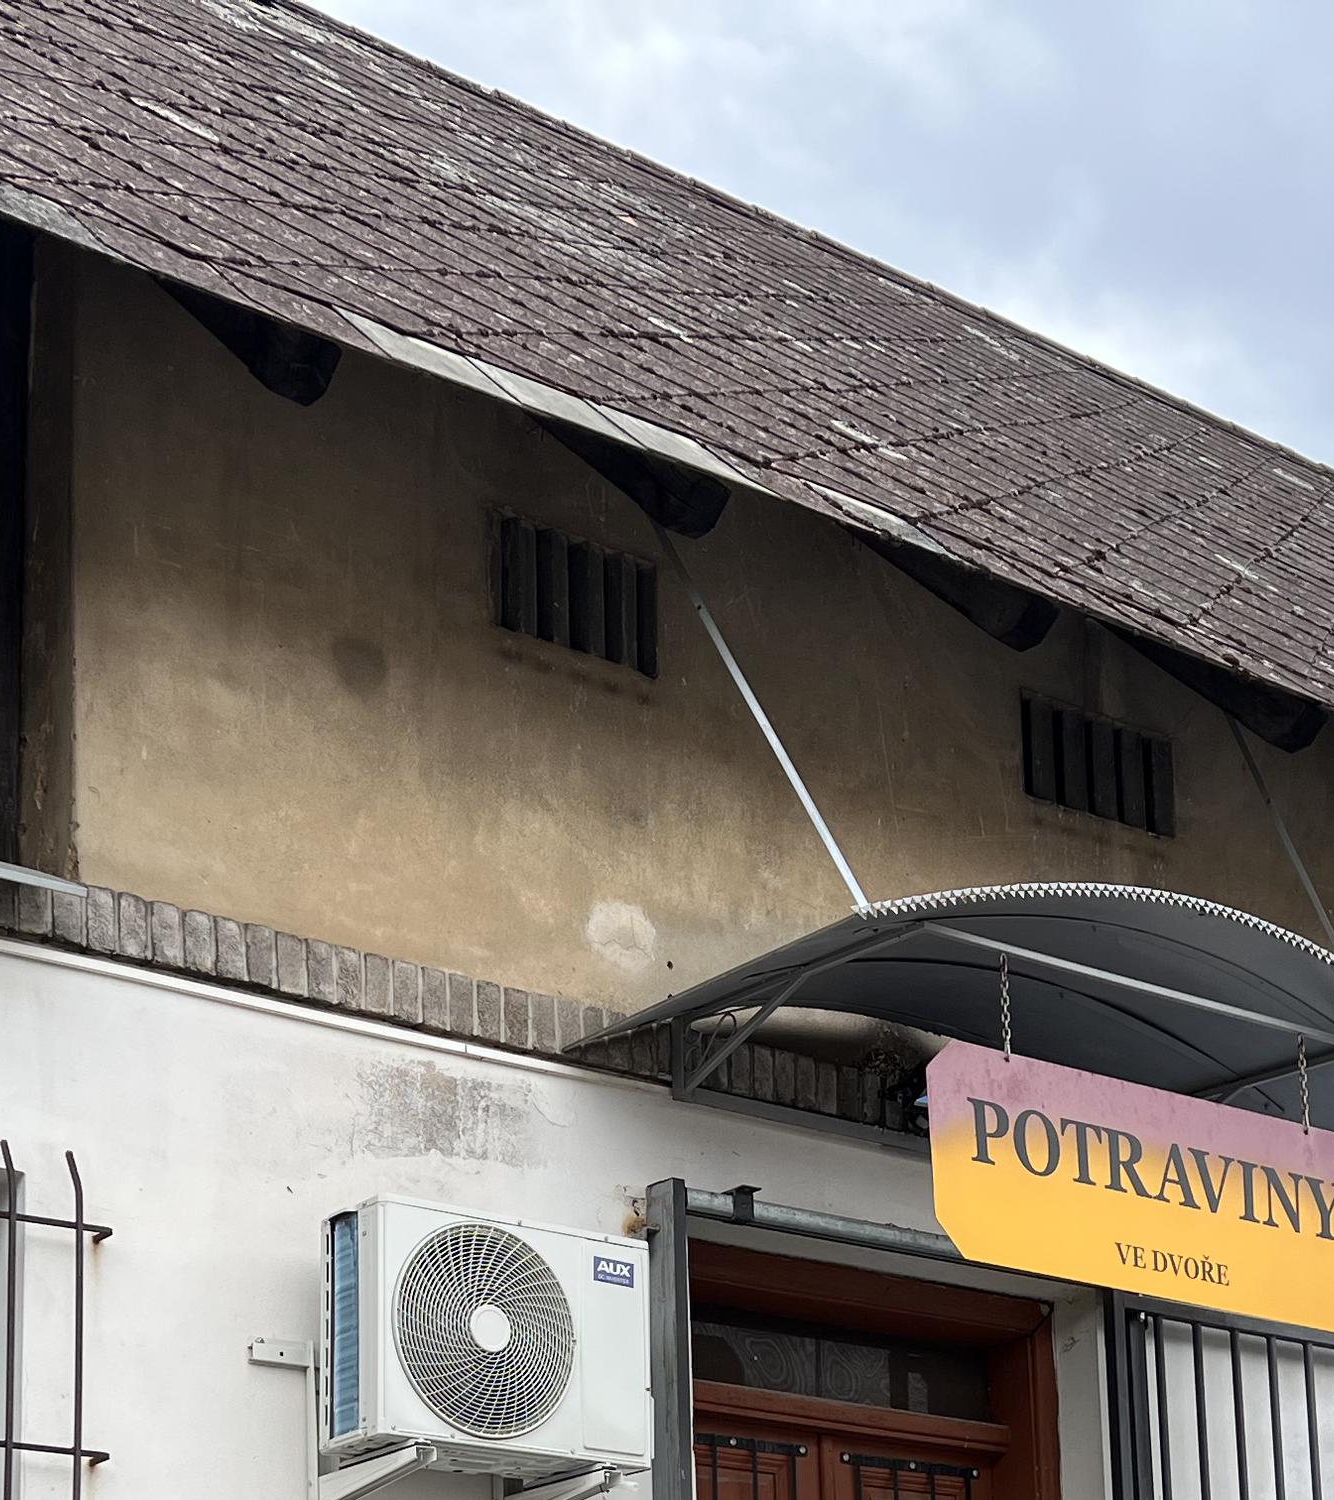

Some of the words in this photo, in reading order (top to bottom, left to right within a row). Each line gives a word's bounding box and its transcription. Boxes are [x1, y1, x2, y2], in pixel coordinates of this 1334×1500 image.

[597, 1260, 630, 1277] AUX
[1115, 1242, 1146, 1269] VE
[1152, 1250, 1230, 1287] DVOŘE
